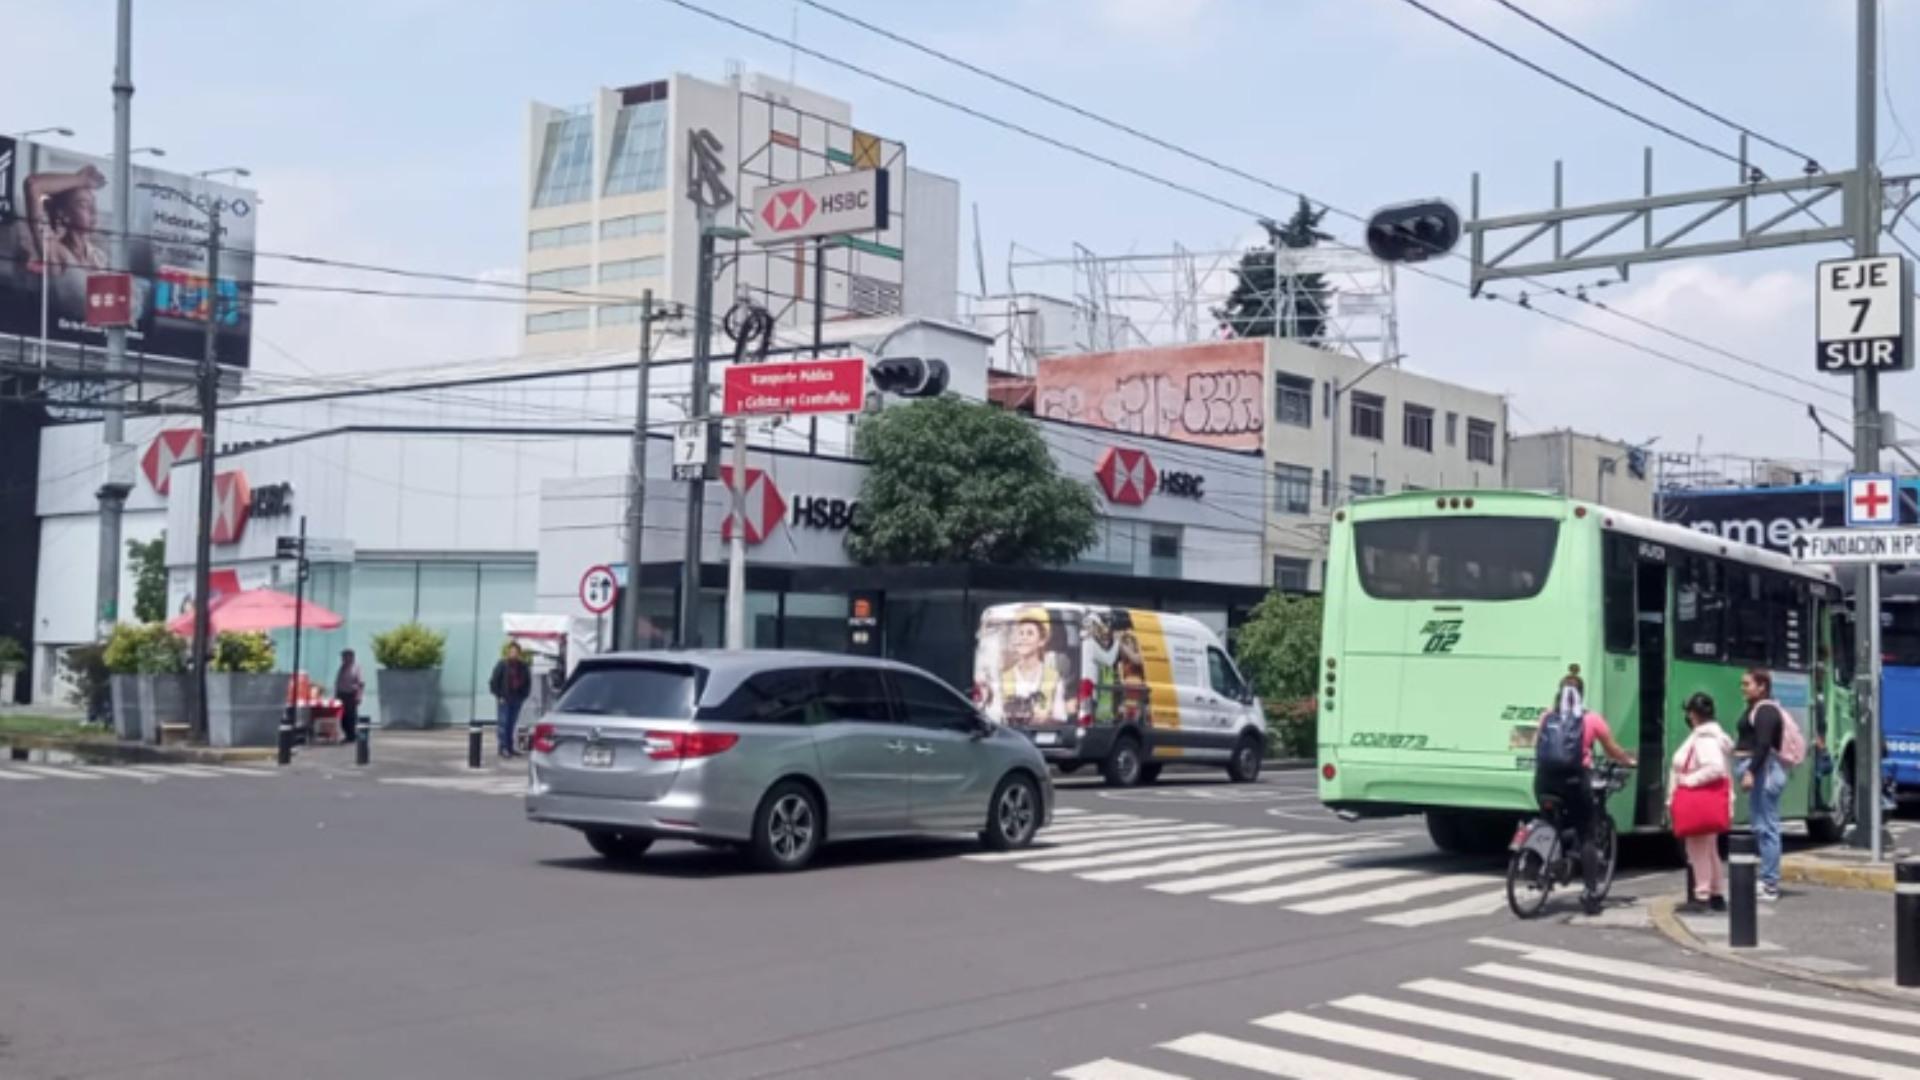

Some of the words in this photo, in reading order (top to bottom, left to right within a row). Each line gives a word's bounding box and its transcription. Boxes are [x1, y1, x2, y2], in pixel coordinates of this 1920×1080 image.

[821, 189, 868, 215] HSBC
[1831, 262, 1887, 290] EJE
[1848, 298, 1872, 333] 7
[1826, 340, 1894, 369] SUR
[686, 441, 696, 460] 7
[1160, 470, 1205, 498] HSBC
[1422, 633, 1461, 654] 02
